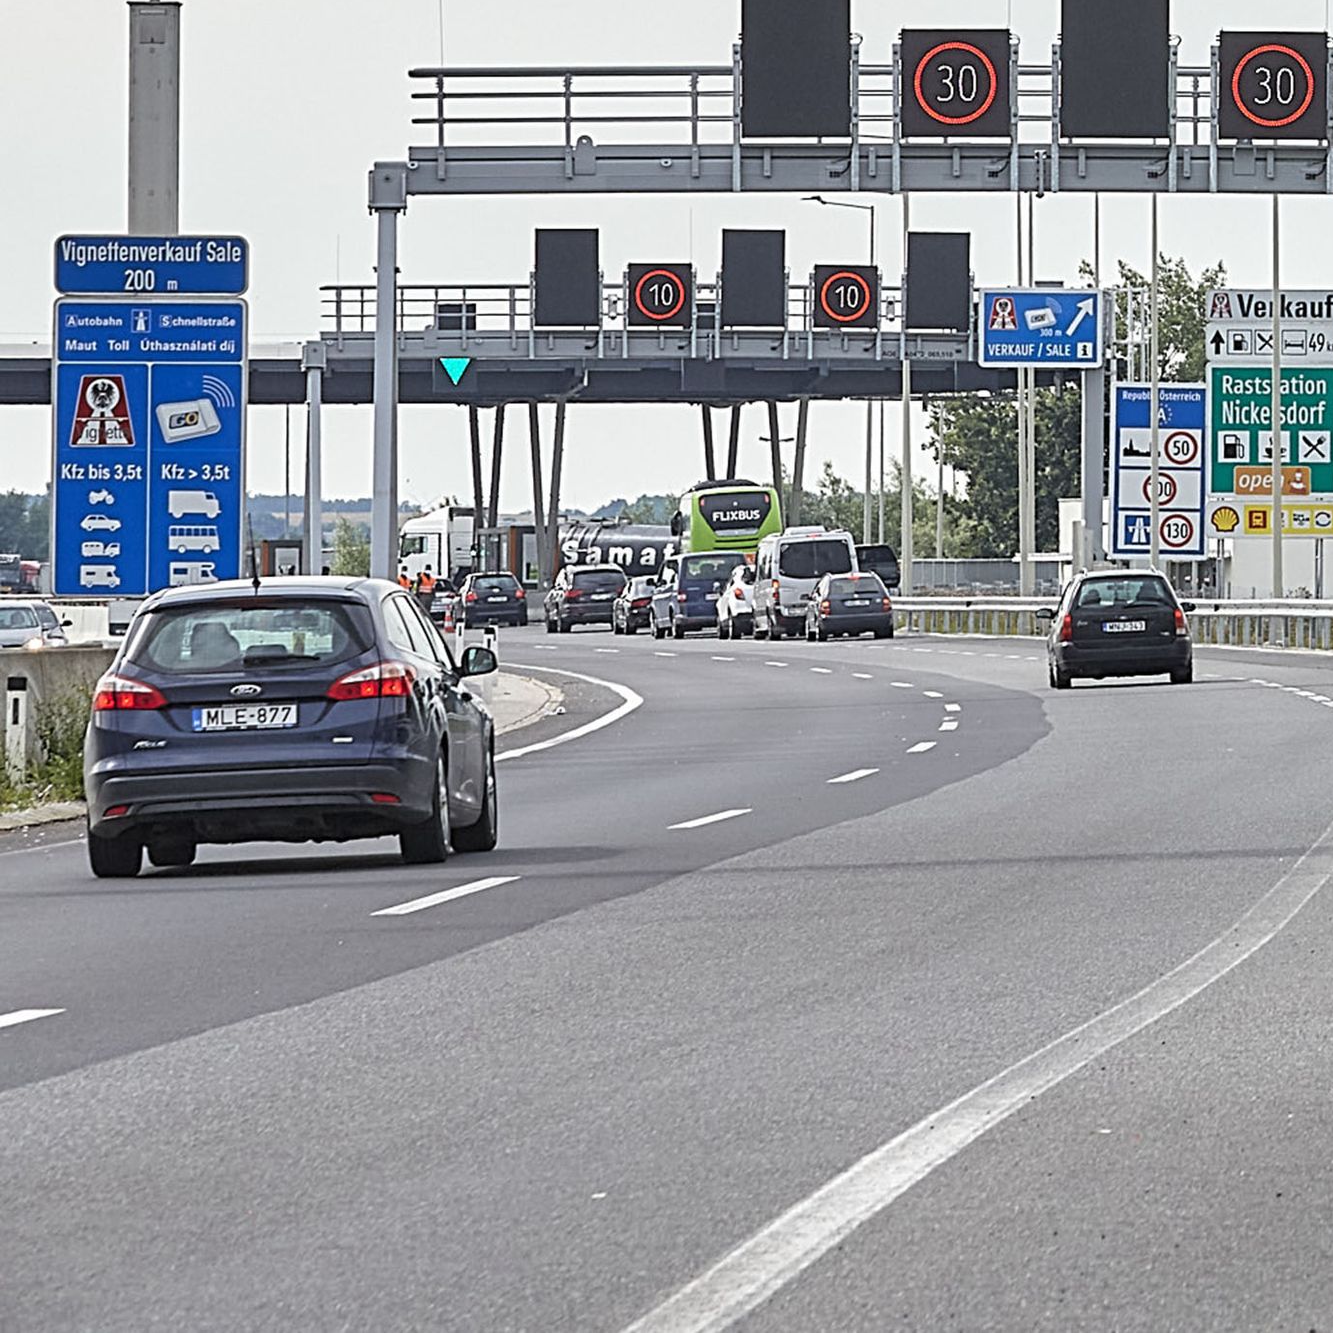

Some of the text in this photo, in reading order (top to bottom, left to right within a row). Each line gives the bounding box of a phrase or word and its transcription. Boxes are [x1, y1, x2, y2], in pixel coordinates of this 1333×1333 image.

[935, 64, 977, 102] 30
[1253, 65, 1294, 106] 30
[61, 240, 242, 266] Vignettenverkauf Sale
[124, 269, 178, 291] 200 m
[648, 283, 675, 306] 10
[834, 284, 860, 308] 10
[67, 316, 123, 327] Autobahn
[161, 315, 236, 327] Schnellstraße
[65, 339, 236, 354] Maut Toll Úthasználati díj
[987, 343, 1035, 357] VERKAUF
[1045, 343, 1071, 357] SALE
[1308, 332, 1326, 352] 49
[1222, 374, 1327, 395] Rastsation
[1222, 399, 1327, 425] Nickesdorf
[1172, 440, 1190, 455] 50
[61, 464, 142, 482] Kfz bis 3,5t
[161, 464, 185, 480] Kfz
[201, 464, 230, 482] 3,5t
[1149, 481, 1171, 497] 00
[712, 508, 761, 523] FLIXBUS
[1166, 522, 1189, 539] 130
[206, 706, 292, 726] MLE-877
